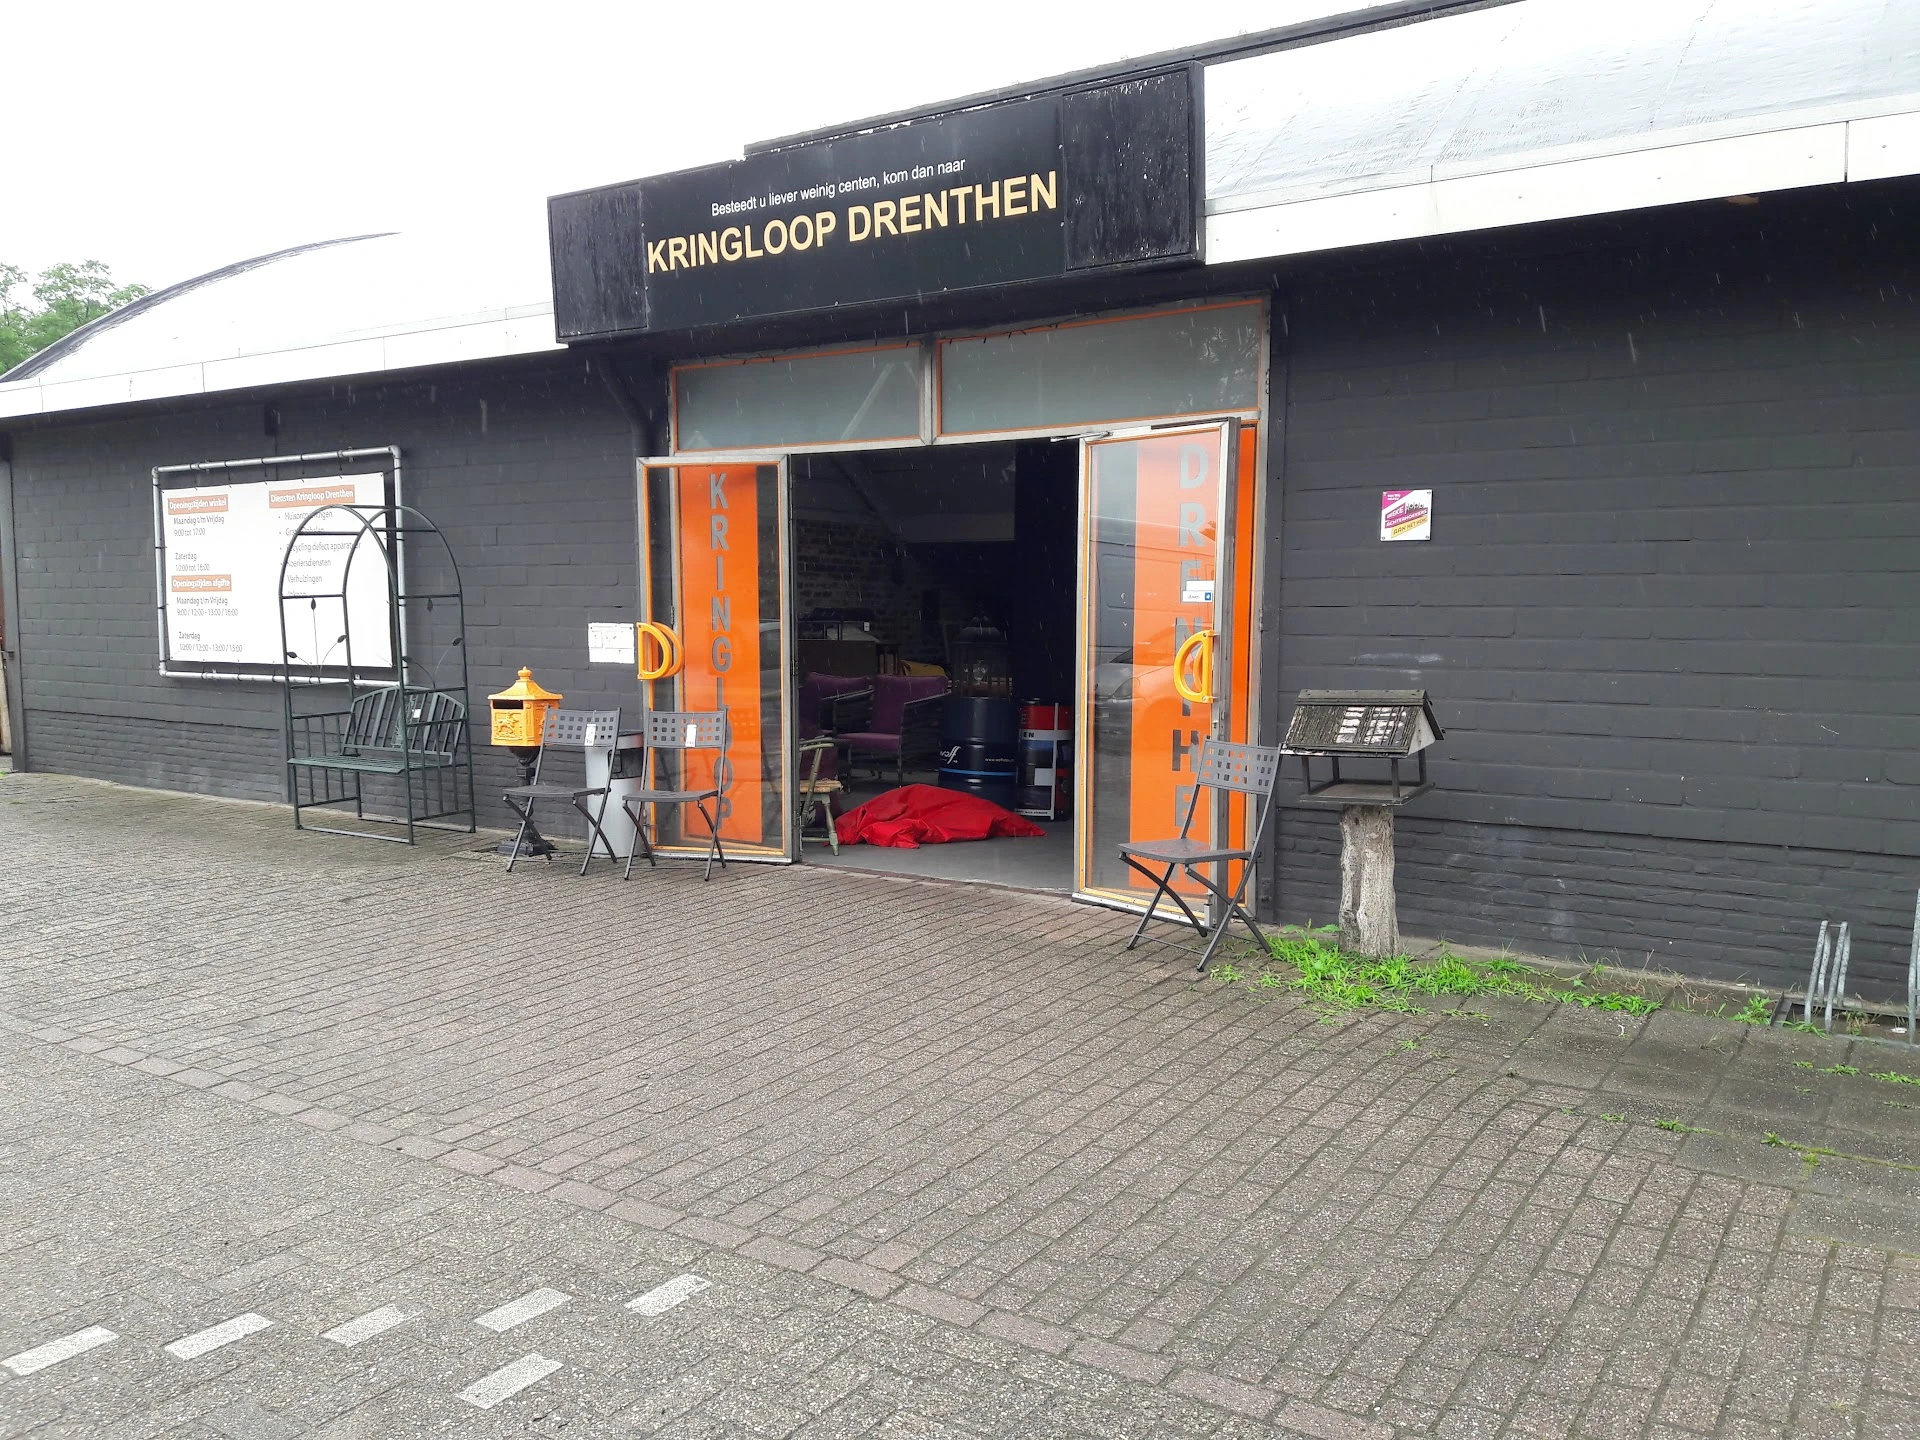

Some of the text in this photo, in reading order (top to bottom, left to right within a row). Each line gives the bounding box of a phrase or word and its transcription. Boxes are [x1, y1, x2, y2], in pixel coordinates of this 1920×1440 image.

[711, 158, 966, 216] Besteedt u liever weinig centen, kom dan naar
[647, 170, 1057, 274] KRINGLOOP DRENTHEN
[270, 489, 354, 502] Diensten Kringloop Drenthen
[169, 497, 227, 511] Openingstijden winkel
[173, 516, 197, 526] Maandag
[207, 515, 225, 525] Vrijdag
[175, 552, 198, 562] Zaterdag
[173, 578, 213, 589] Openingstijden
[176, 596, 200, 606] Maandag
[209, 596, 228, 606] Vrijdag
[178, 631, 201, 641] Zaterdag
